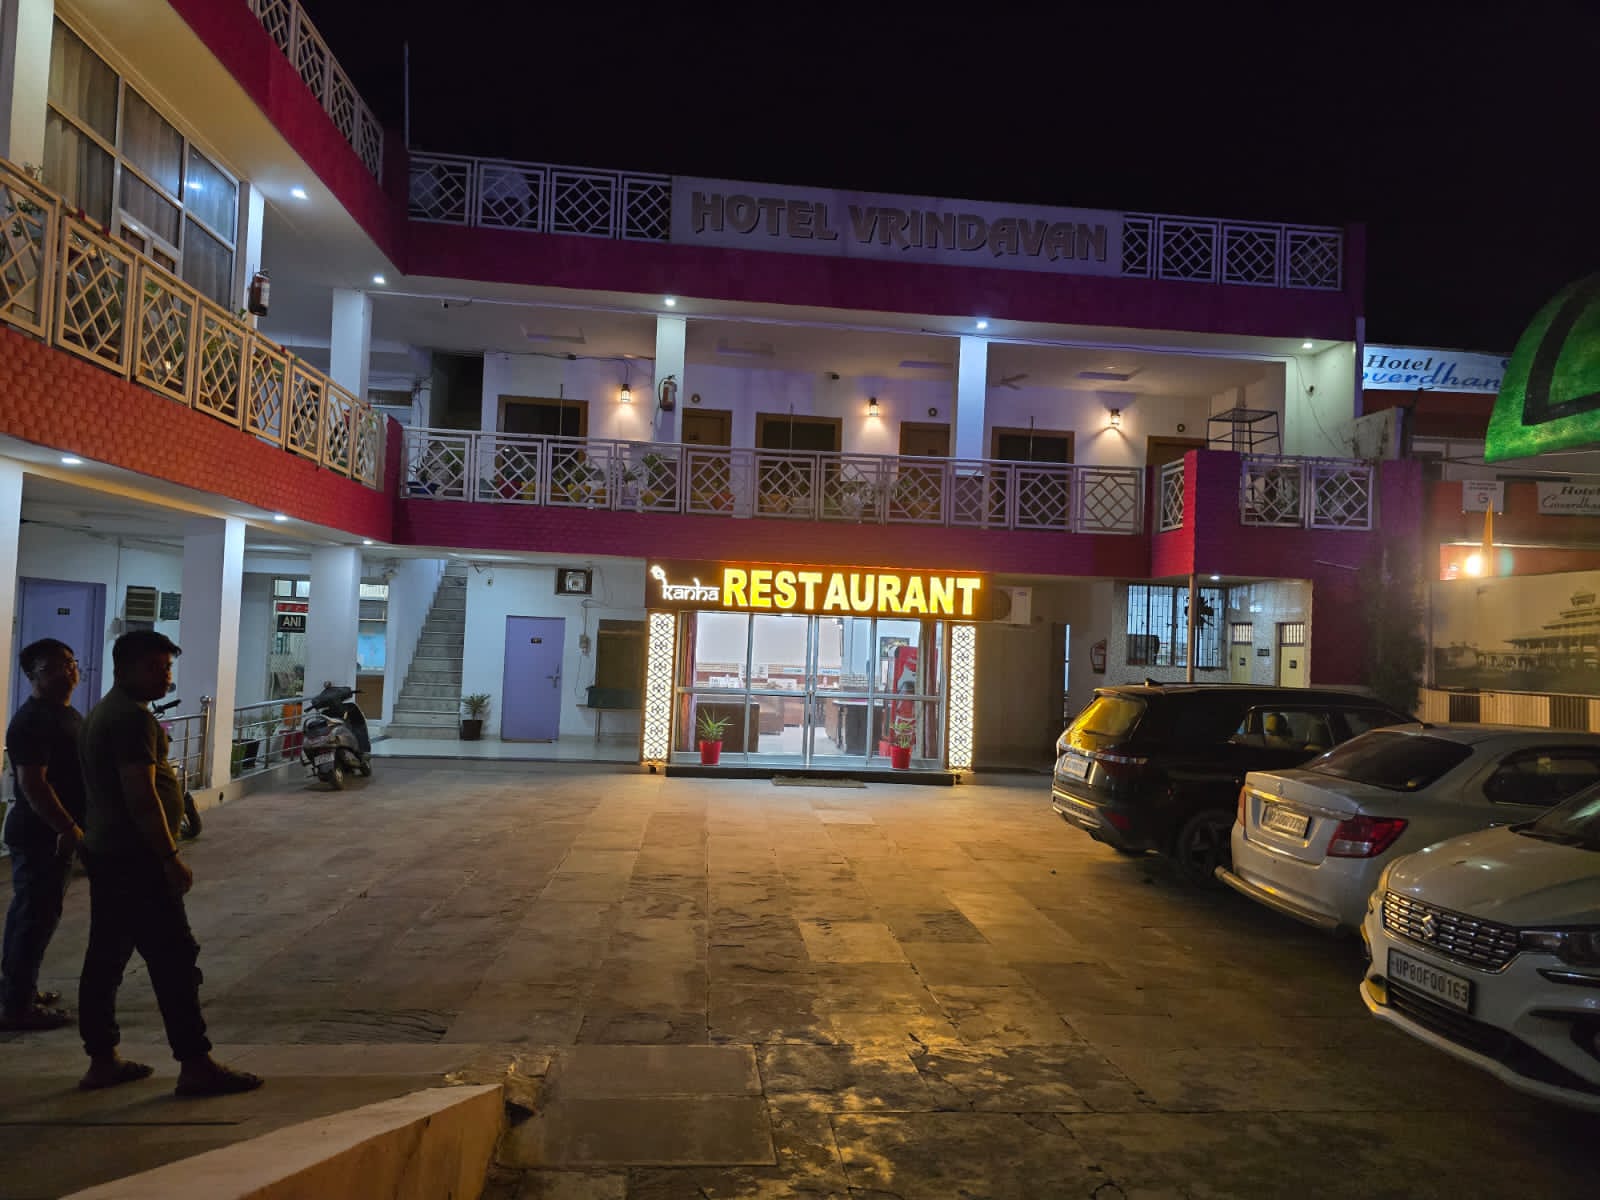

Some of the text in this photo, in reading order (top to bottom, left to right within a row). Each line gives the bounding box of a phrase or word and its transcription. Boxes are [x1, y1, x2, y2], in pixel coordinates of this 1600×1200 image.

[690, 190, 1108, 263] HOTEL VRINDAVAN
[1366, 355, 1433, 371] Hotel
[722, 567, 981, 616] RESTAURANT
[282, 615, 302, 627] ANI
